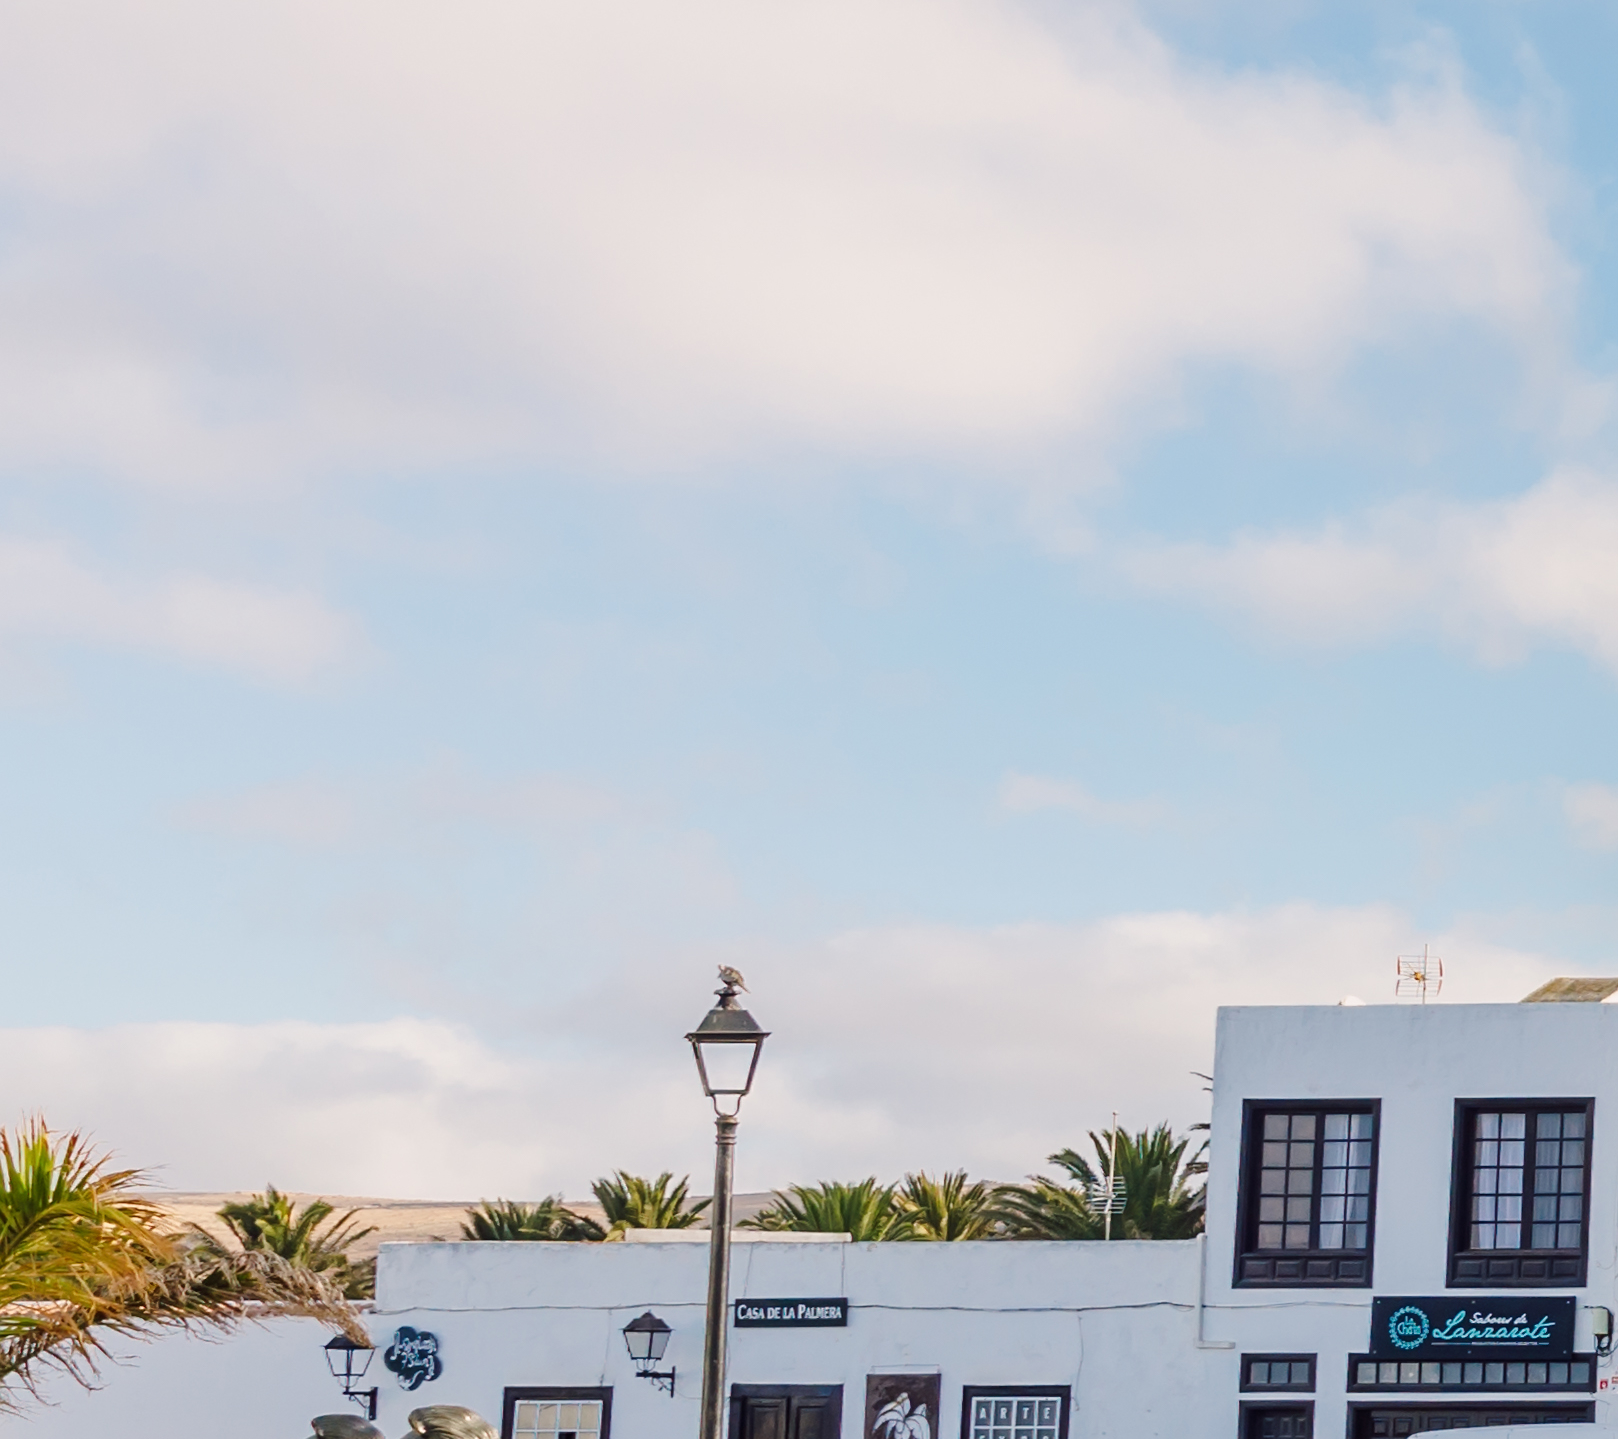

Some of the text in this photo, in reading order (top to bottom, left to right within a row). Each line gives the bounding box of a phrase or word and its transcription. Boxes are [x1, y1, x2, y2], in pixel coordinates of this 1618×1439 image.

[737, 1303, 842, 1320] CASA DE LA PALMERA
[1513, 1313, 1528, 1324] de
[1432, 1310, 1556, 1340] Lanzarote
[979, 1407, 1051, 1419] ARTE
